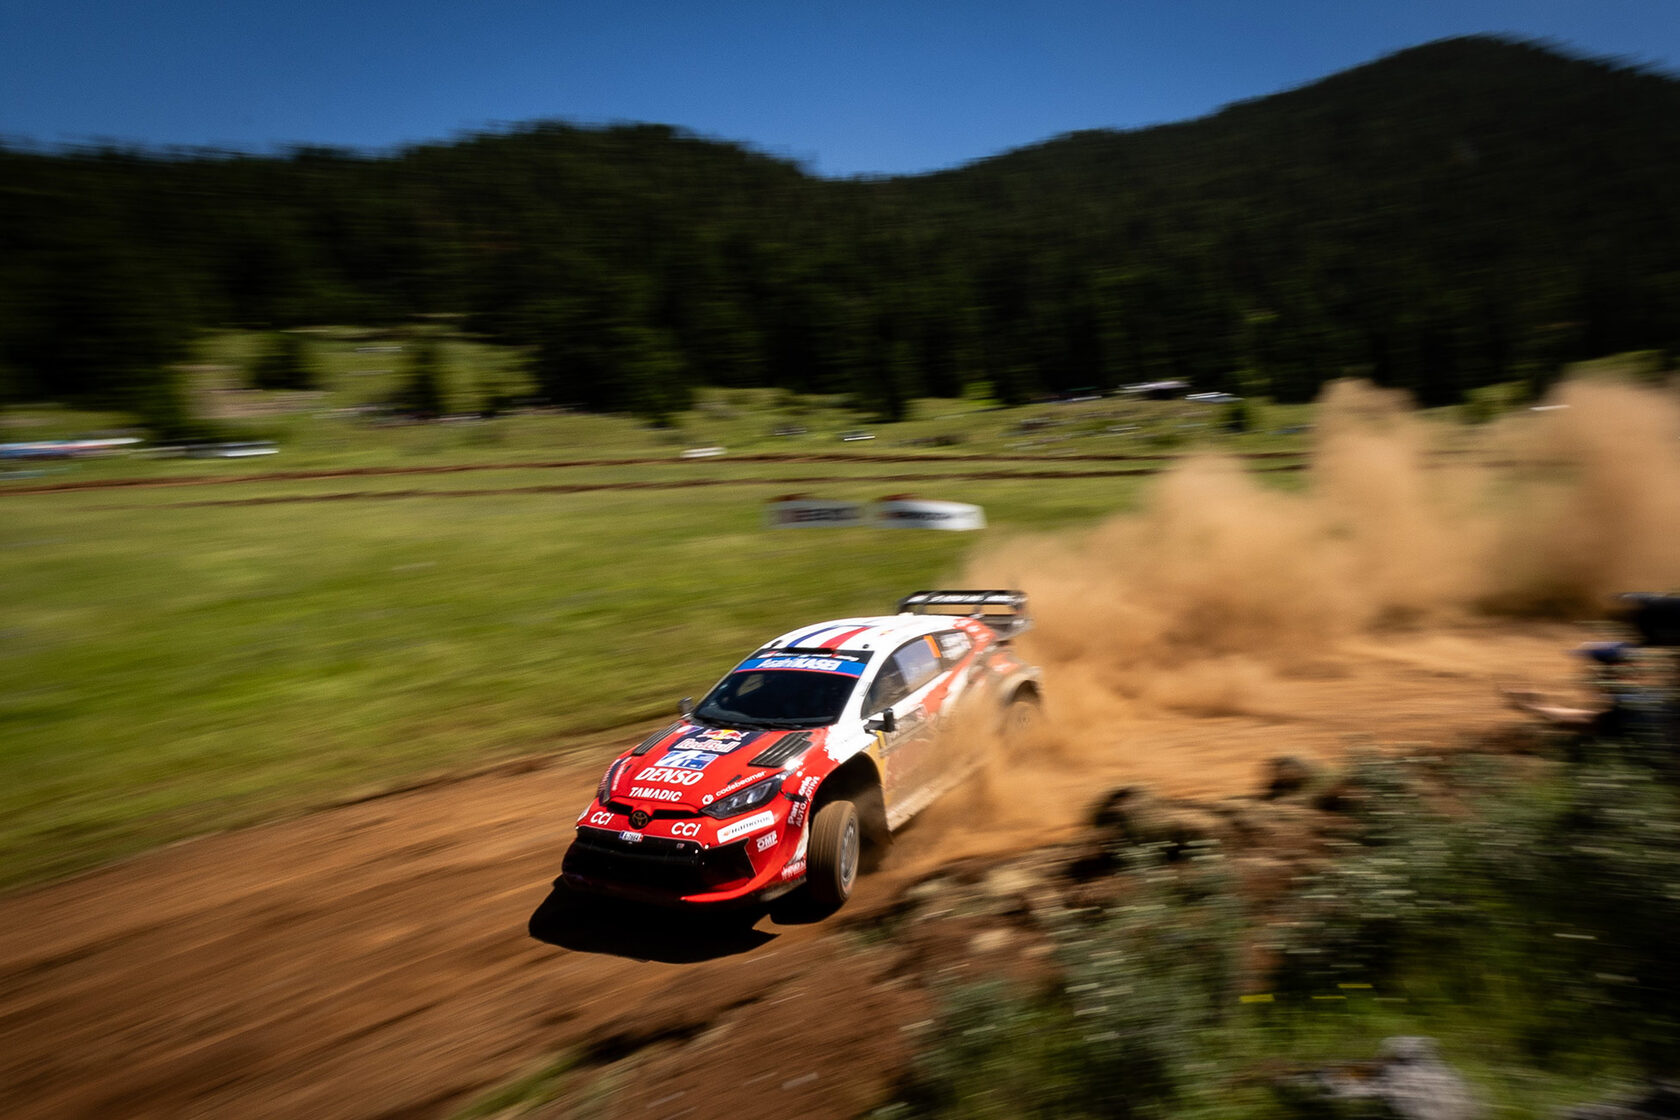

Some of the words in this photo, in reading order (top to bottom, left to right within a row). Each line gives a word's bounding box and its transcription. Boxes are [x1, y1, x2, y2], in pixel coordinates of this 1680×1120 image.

[635, 767, 704, 785] DENSO
[629, 787, 682, 801] TAMADIC
[757, 832, 778, 850] OMP
